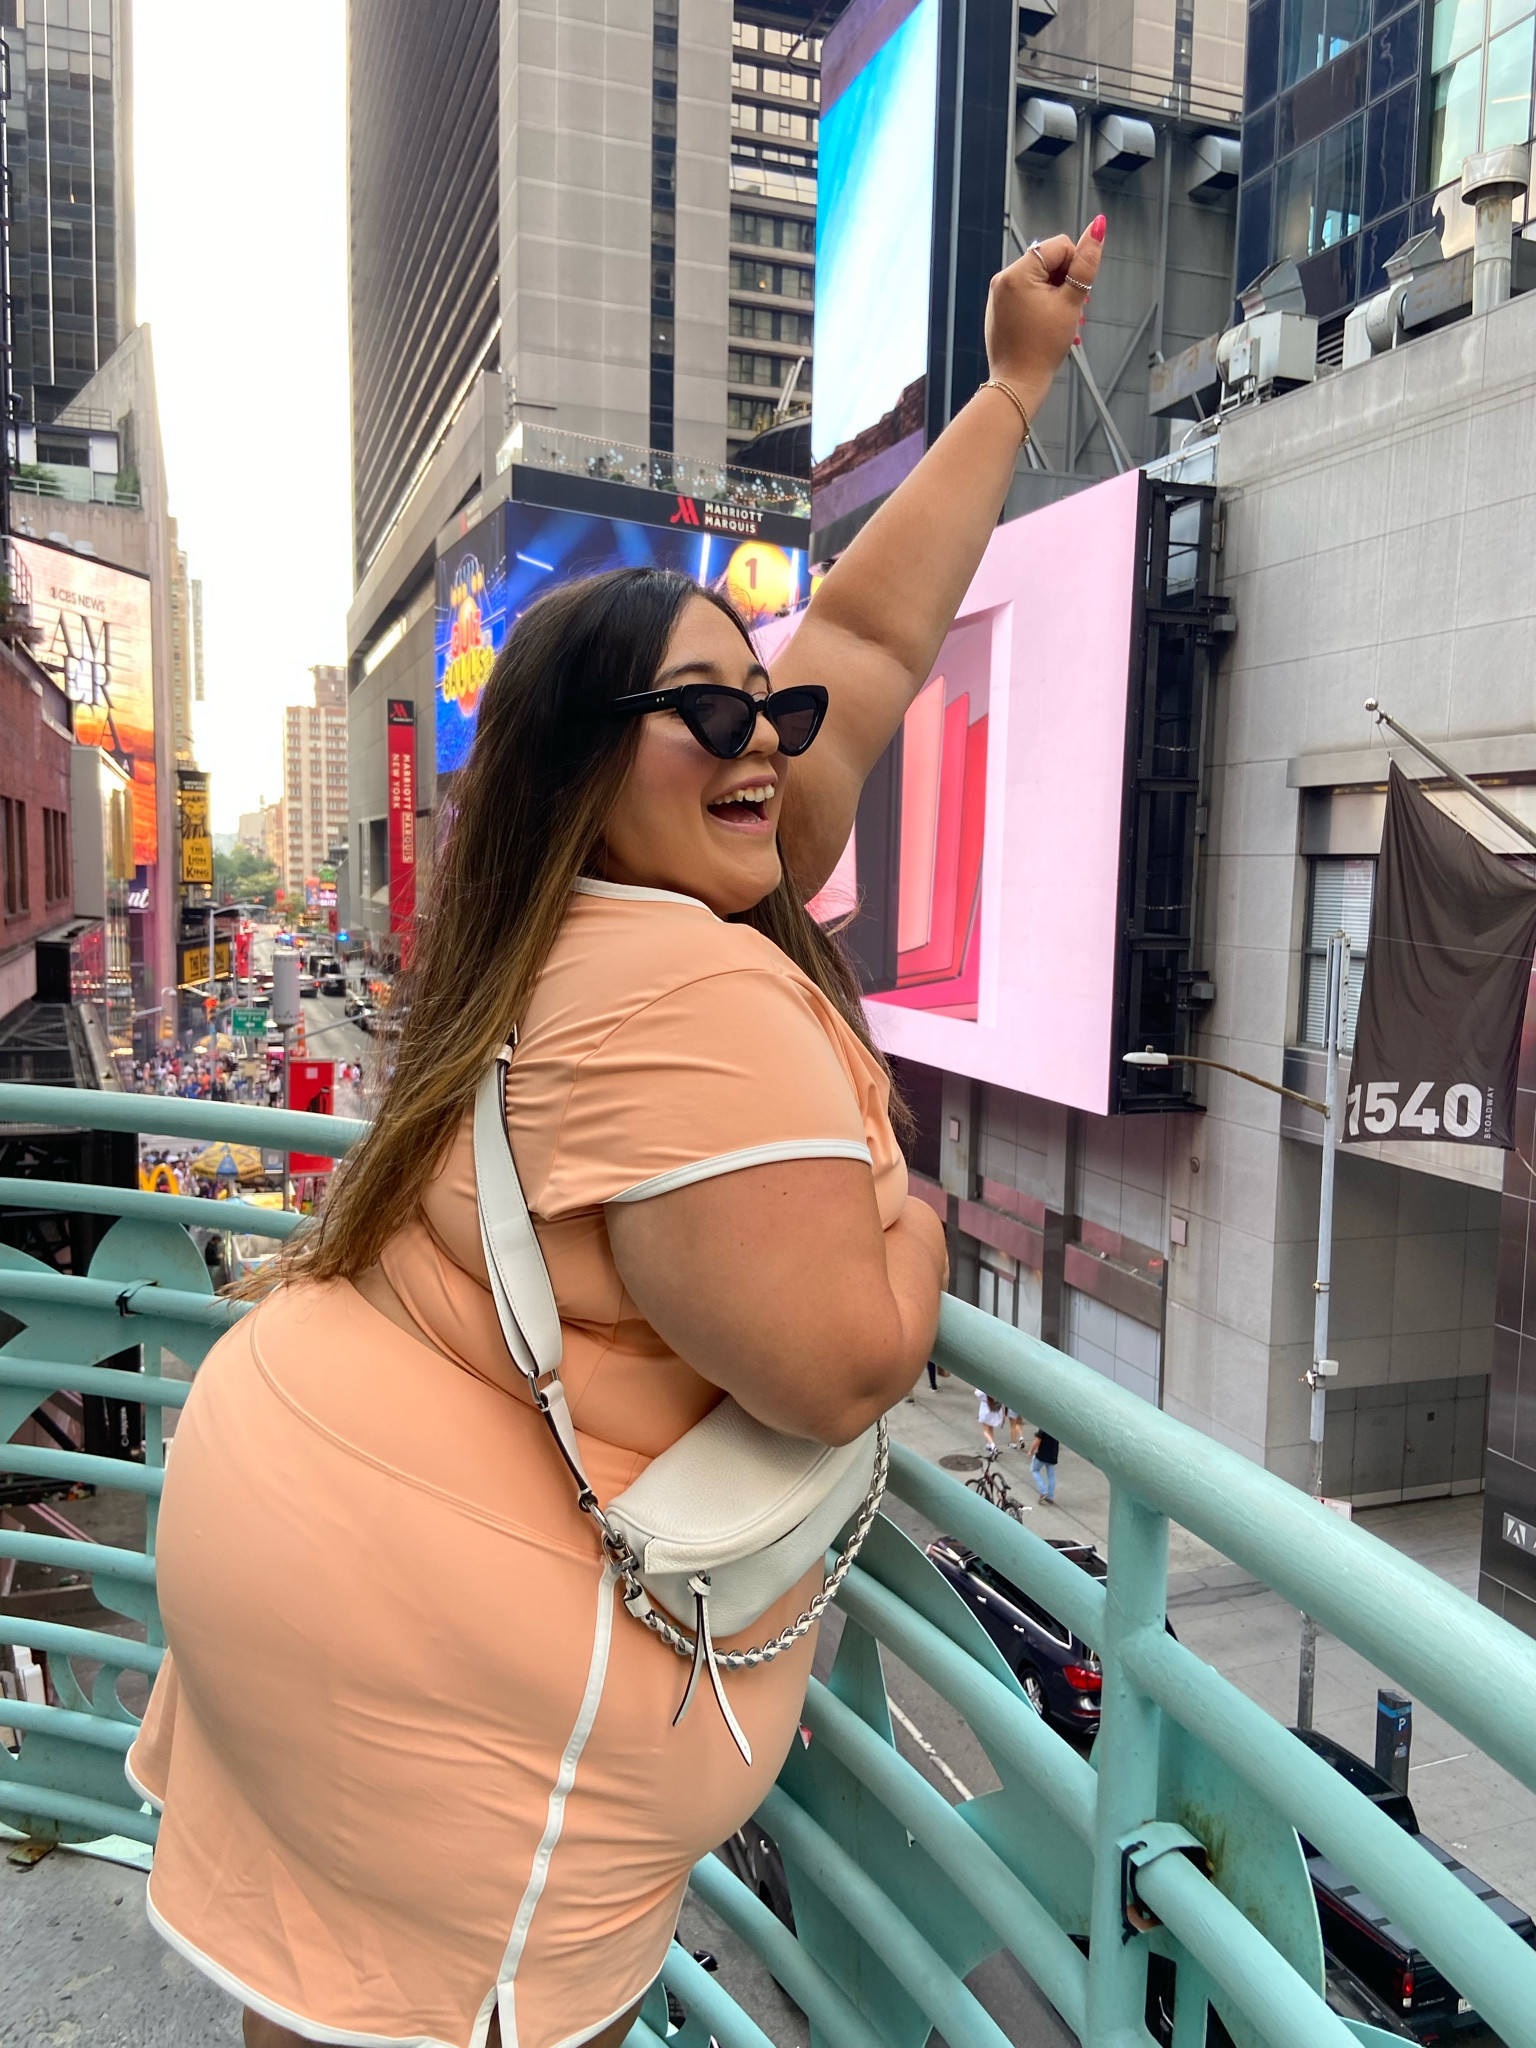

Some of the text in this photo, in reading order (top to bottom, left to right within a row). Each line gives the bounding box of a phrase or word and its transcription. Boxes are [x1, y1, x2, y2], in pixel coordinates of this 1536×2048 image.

[705, 502, 763, 522] MARRIOTT
[705, 516, 756, 534] MARQUIS
[745, 558, 758, 590] 1
[58, 589, 106, 613] CBS NEWS
[392, 753, 400, 809] NEW YORK
[402, 753, 413, 863] MARRIOTT MARQUIS
[186, 866, 209, 878] KING
[188, 855, 207, 866] LION
[1347, 1081, 1483, 1138] 1540
[1483, 1086, 1495, 1139] BROADWAY
[1398, 1717, 1407, 1731] P
